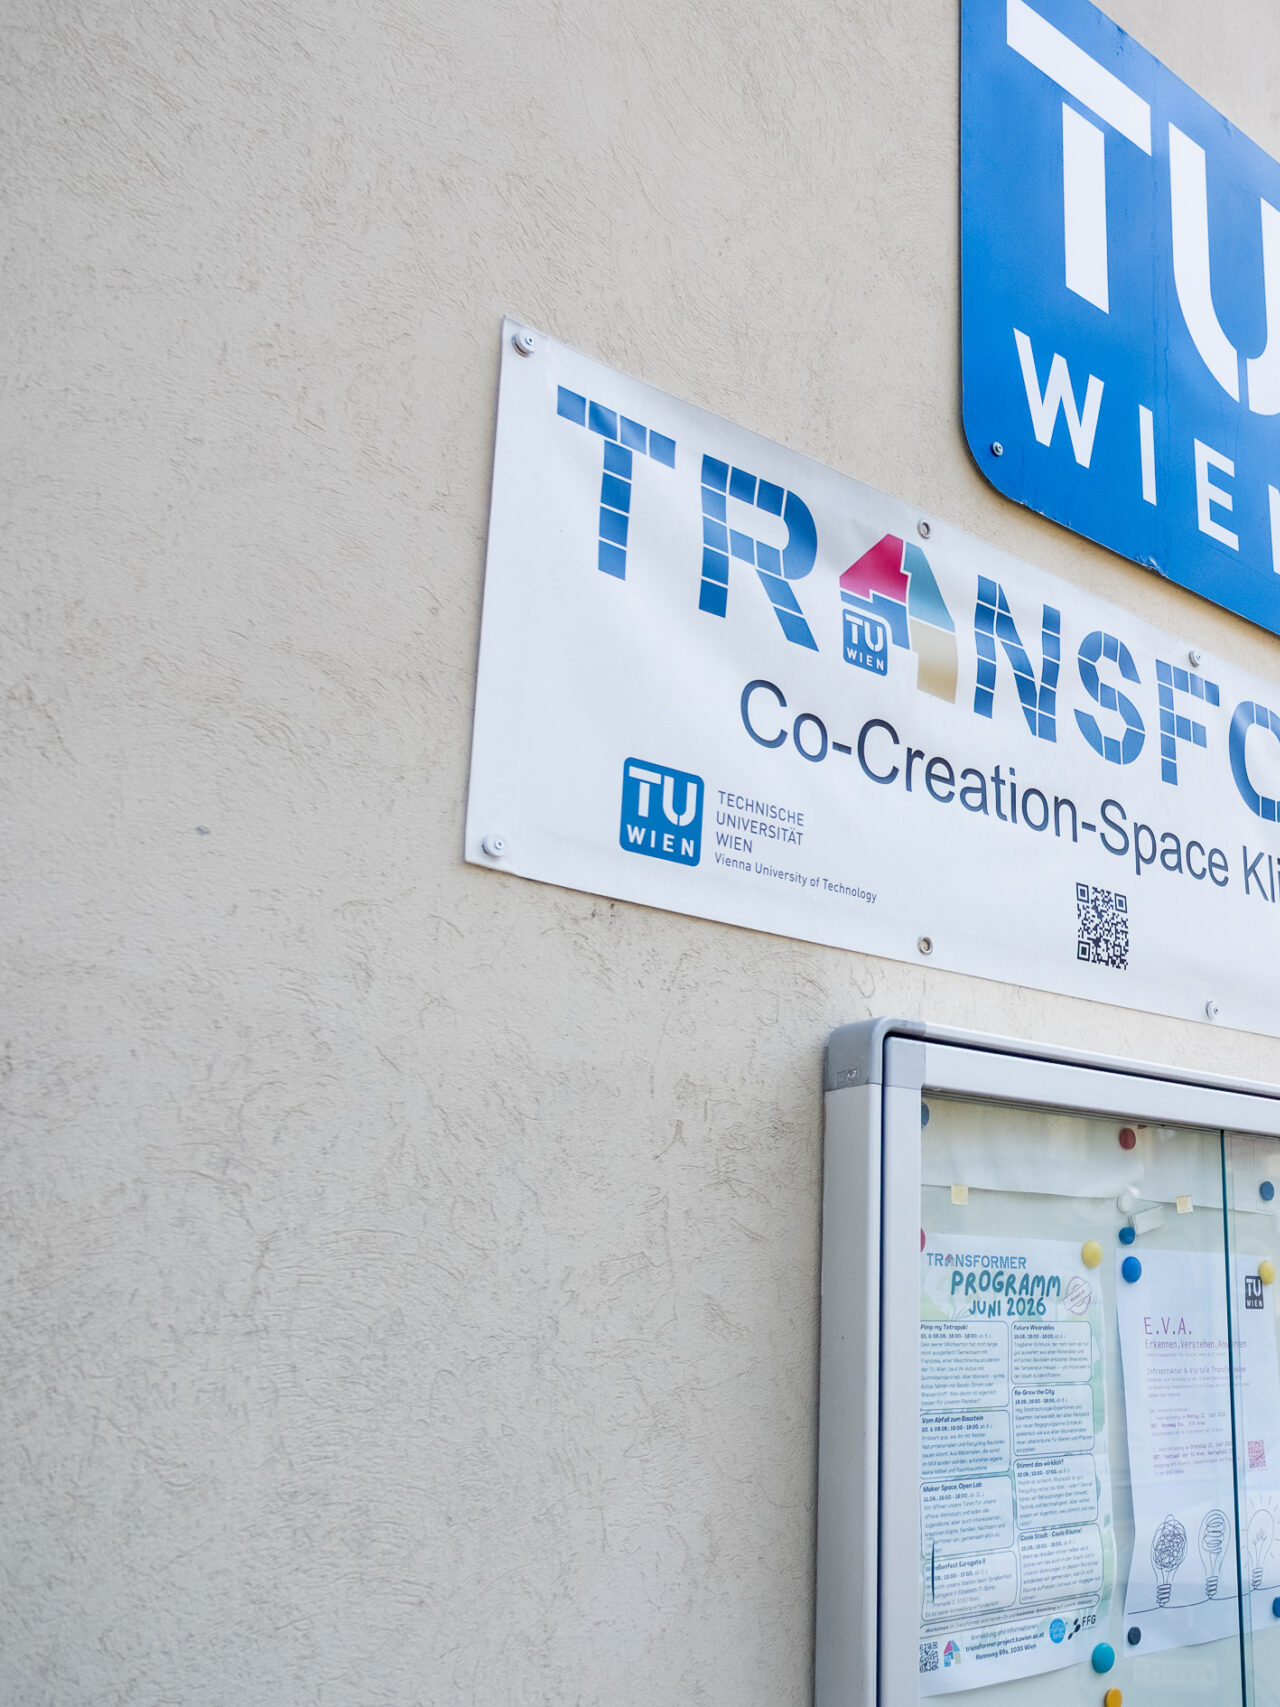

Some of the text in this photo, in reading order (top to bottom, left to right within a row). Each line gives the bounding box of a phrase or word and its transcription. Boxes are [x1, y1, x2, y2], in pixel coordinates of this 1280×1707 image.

[845, 613, 886, 653] TU
[846, 647, 885, 672] WIEN
[629, 766, 698, 826] TU
[740, 679, 1229, 887] Co-Creation-Space
[718, 790, 804, 827] TECHNISCHE
[716, 811, 804, 846] UNIVERSITÄT
[626, 827, 695, 859] WIEN
[715, 831, 753, 853] WIEN
[714, 852, 877, 904] Vienna University of Technology
[926, 1253, 1027, 1269] TRANSFORMER
[951, 1270, 1061, 1297] PROGRAMM
[969, 1296, 1046, 1318] JUNI 2026
[1143, 1317, 1192, 1335] E.V.A.
[958, 1482, 972, 1490] Open
[1082, 1614, 1096, 1627] FFG
[975, 1651, 998, 1661] Rennweg
[1024, 1643, 1037, 1652] Wien
